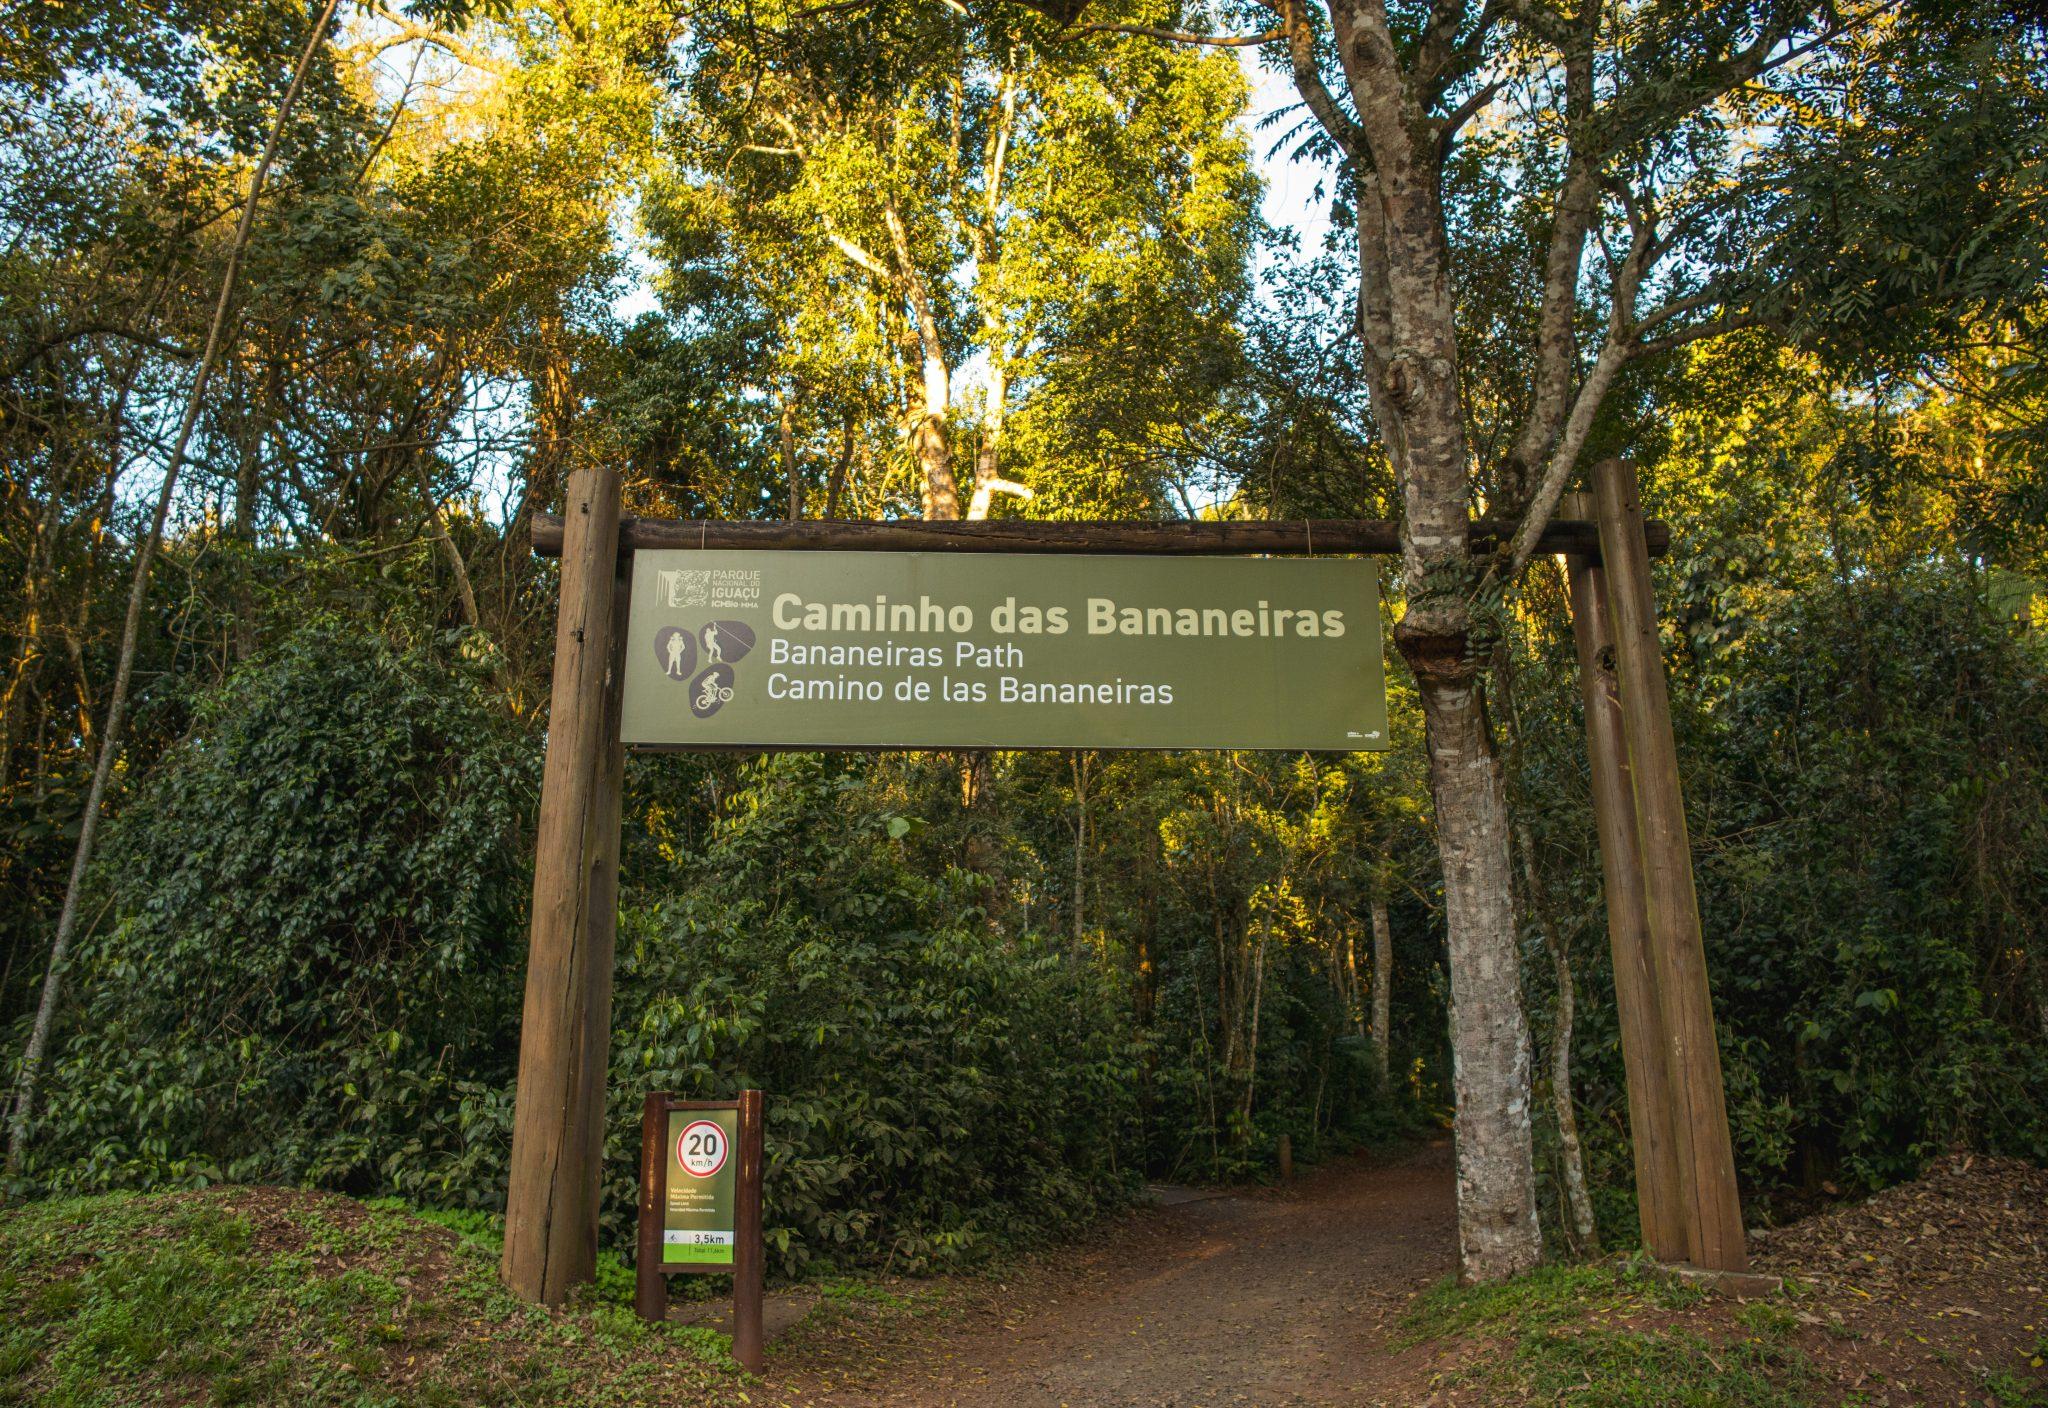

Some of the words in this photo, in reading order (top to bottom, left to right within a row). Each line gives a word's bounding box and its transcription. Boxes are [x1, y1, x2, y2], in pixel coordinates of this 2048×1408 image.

[713, 570, 760, 580] PARQUE
[711, 588, 760, 600] IGUAÇU
[772, 593, 973, 633] Caminho
[991, 597, 1069, 635] das
[1088, 598, 1345, 638] Bananeiras
[770, 638, 943, 667] Bananeiras
[956, 641, 1023, 668] Path
[767, 672, 883, 701] Camino
[894, 675, 930, 701] de
[943, 676, 987, 702] las
[1000, 676, 1174, 704] Bananeiras
[689, 1134, 717, 1155] 20
[691, 1158, 713, 1167] km/h
[694, 1234, 725, 1246] 3,5km
